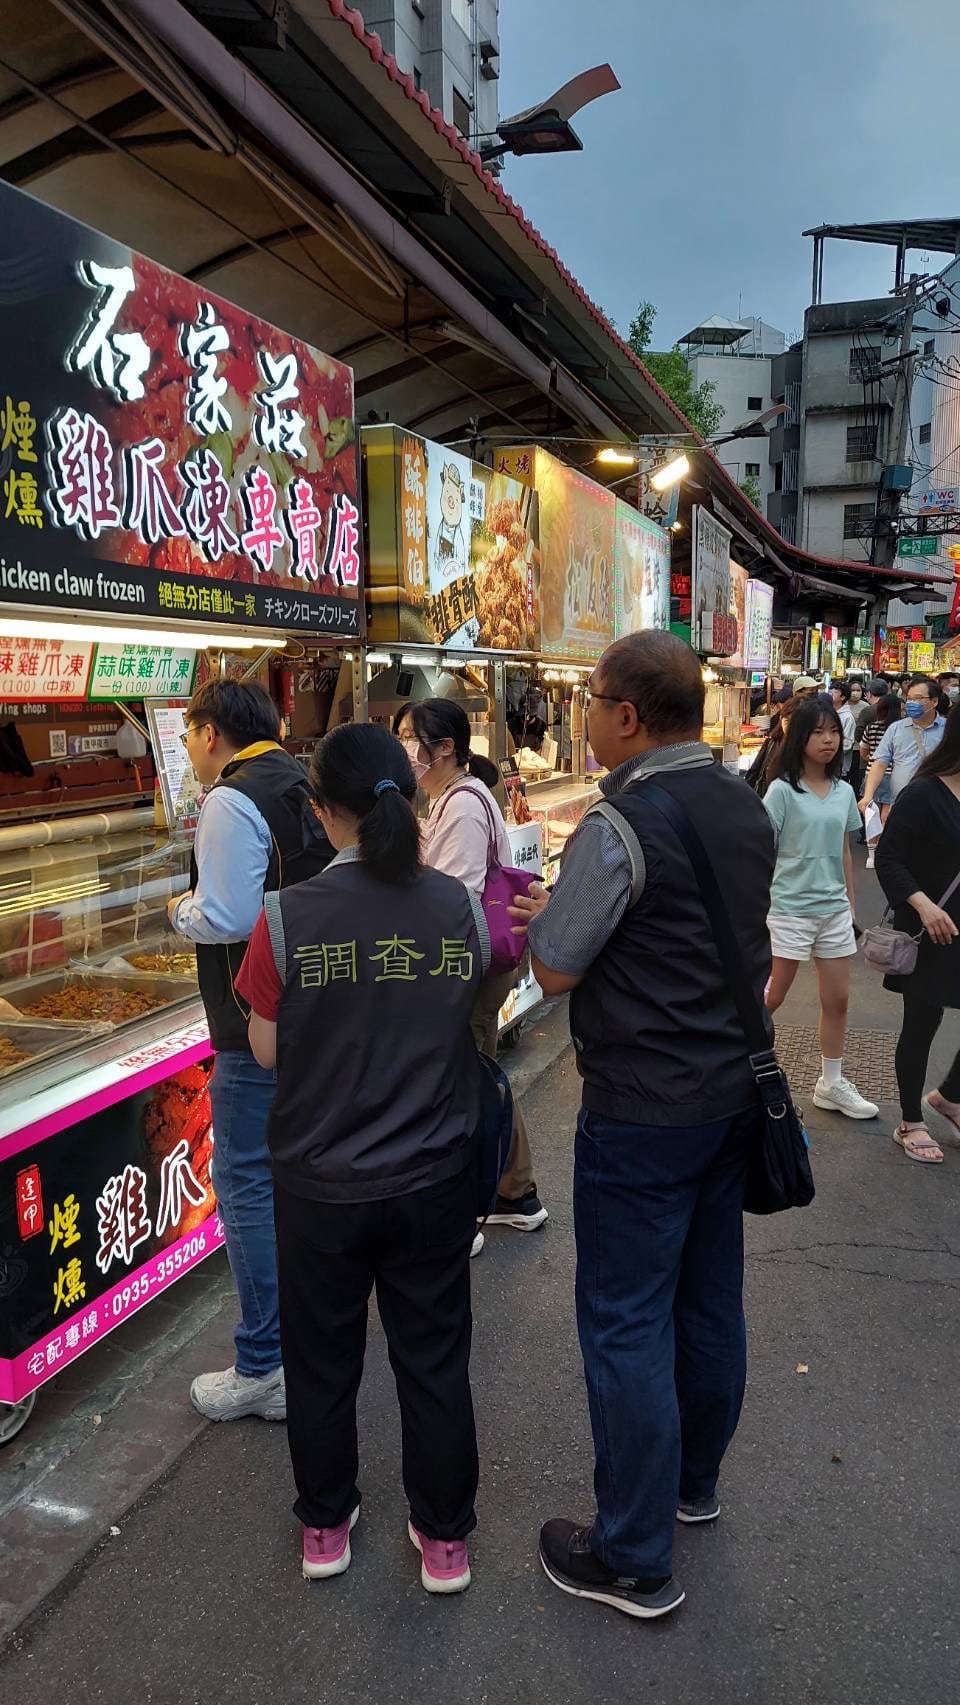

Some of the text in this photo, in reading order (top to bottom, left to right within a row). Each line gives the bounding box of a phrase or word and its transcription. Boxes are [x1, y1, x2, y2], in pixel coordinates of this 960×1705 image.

[66, 261, 305, 457] 石家莊
[1, 396, 43, 529] 煙燻
[48, 408, 360, 586] 雞爪凍專賣店
[936, 490, 955, 500] WC
[0, 558, 145, 603] icken claw frozen
[158, 581, 258, 617] 絕無分店僅此一家
[264, 596, 358, 628] チキンクローズフリーズ
[97, 655, 191, 679] 蒜味雞爪凍
[293, 933, 474, 990] 調查局
[19, 1176, 38, 1231] 逢甲
[48, 1193, 87, 1315] 煙燻
